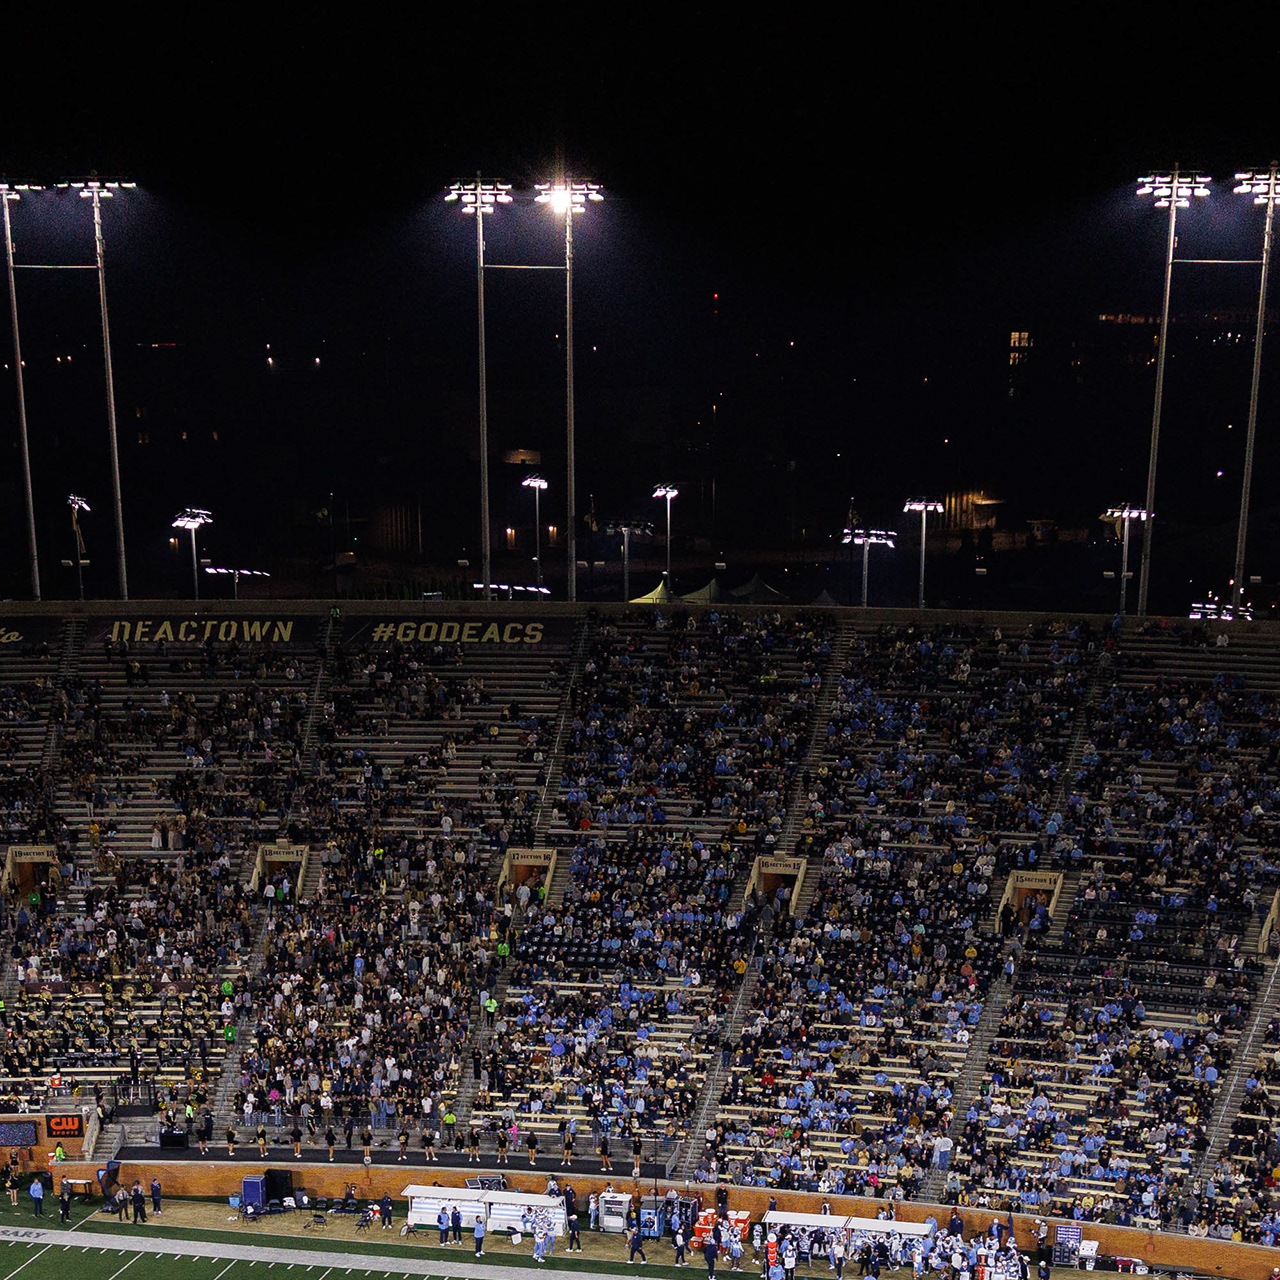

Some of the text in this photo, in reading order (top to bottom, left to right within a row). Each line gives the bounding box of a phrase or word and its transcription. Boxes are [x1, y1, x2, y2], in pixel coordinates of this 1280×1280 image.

[111, 620, 295, 642] DEACTOWN
[371, 622, 545, 644] #GODEACS
[50, 1117, 80, 1130] CW
